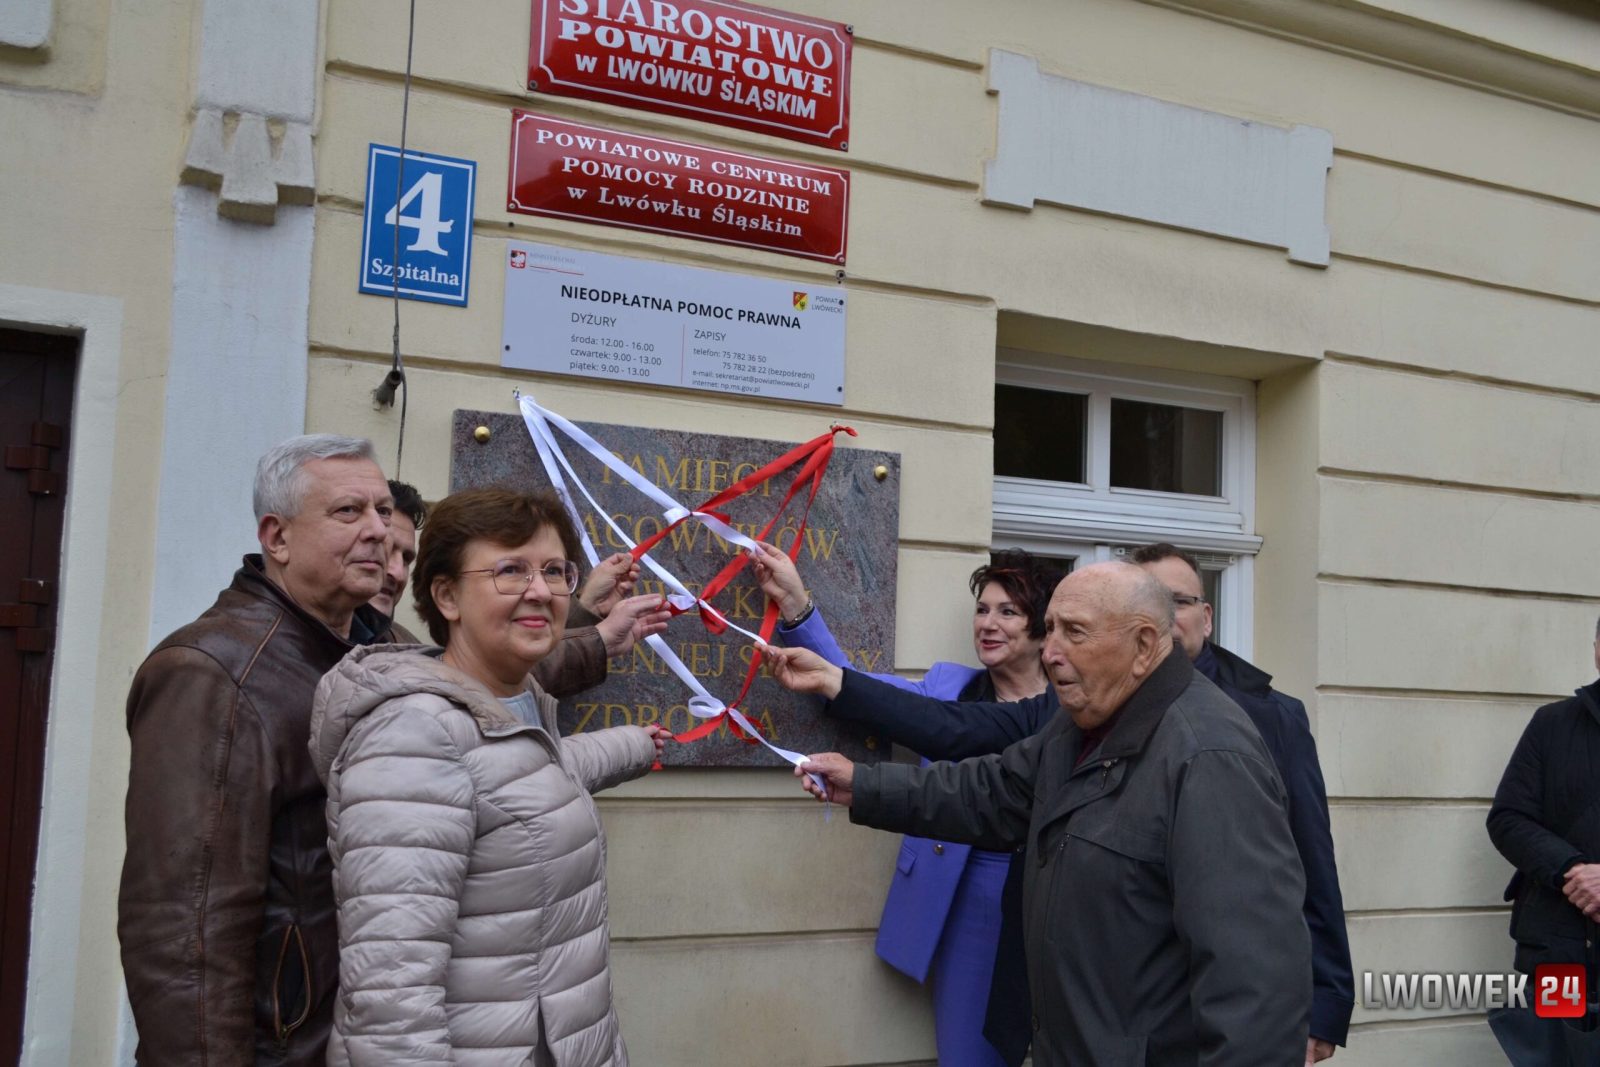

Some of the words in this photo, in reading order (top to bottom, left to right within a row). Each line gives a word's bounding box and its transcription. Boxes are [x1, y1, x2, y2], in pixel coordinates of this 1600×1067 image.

[558, 18, 833, 97] POWIATOWE
[607, 55, 713, 96] LWÓWKU
[719, 76, 817, 120] ŚLĄSKIM
[536, 128, 700, 170] POWIATOWE
[711, 160, 831, 196] CENTRUM
[562, 156, 678, 190] POMOCY
[688, 178, 810, 214] RODZINIE
[385, 171, 455, 257] 4
[598, 187, 701, 219] Lwówku
[711, 203, 802, 237] Śląskim
[371, 258, 460, 287] Szpitalna
[561, 284, 673, 312] NIEODPŁATNA
[677, 301, 734, 320] POMOC
[738, 309, 801, 329] PRAWNA
[815, 295, 838, 304] POWIAT
[571, 312, 617, 327] DYŻURY
[571, 334, 599, 345] środa:
[600, 338, 624, 348] 12.00
[632, 341, 655, 351] 16.00
[694, 329, 726, 341] ZAPISY
[570, 348, 611, 360] czwartek:
[613, 352, 632, 362] 9.00
[639, 355, 662, 366] 13.00
[693, 348, 720, 357] telefon:
[722, 351, 731, 359] 75
[733, 352, 746, 361] 782
[747, 354, 757, 362] 36
[757, 355, 767, 363] 50
[569, 360, 599, 371] piątek:
[601, 363, 620, 373] 9.00
[627, 366, 650, 377] 13.00
[692, 370, 714, 378] e-mail:
[733, 363, 746, 371] 782
[758, 366, 767, 374] 22
[768, 367, 815, 380] (bezpośredni)
[692, 379, 720, 388] internet:
